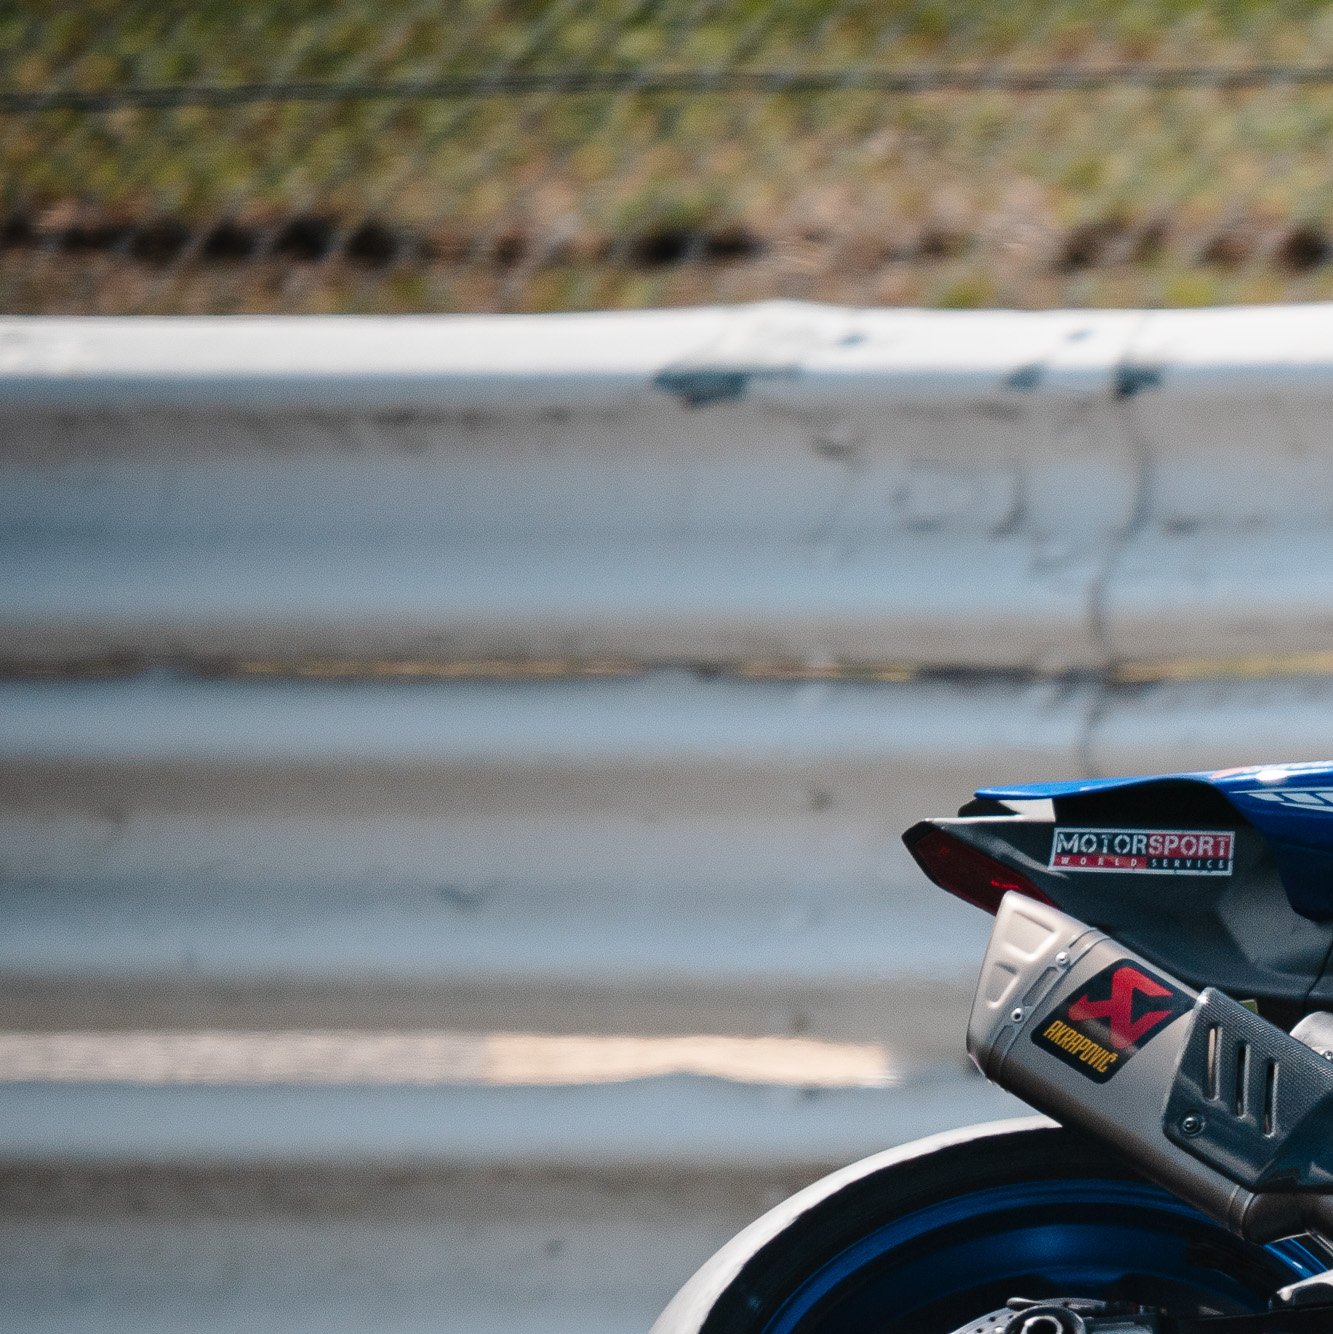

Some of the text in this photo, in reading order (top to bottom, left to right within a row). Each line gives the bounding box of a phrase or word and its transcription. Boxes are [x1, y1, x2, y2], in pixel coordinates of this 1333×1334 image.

[1056, 833, 1230, 857] MOTORSPORT
[1061, 855, 1226, 869] WORLD SERVICE
